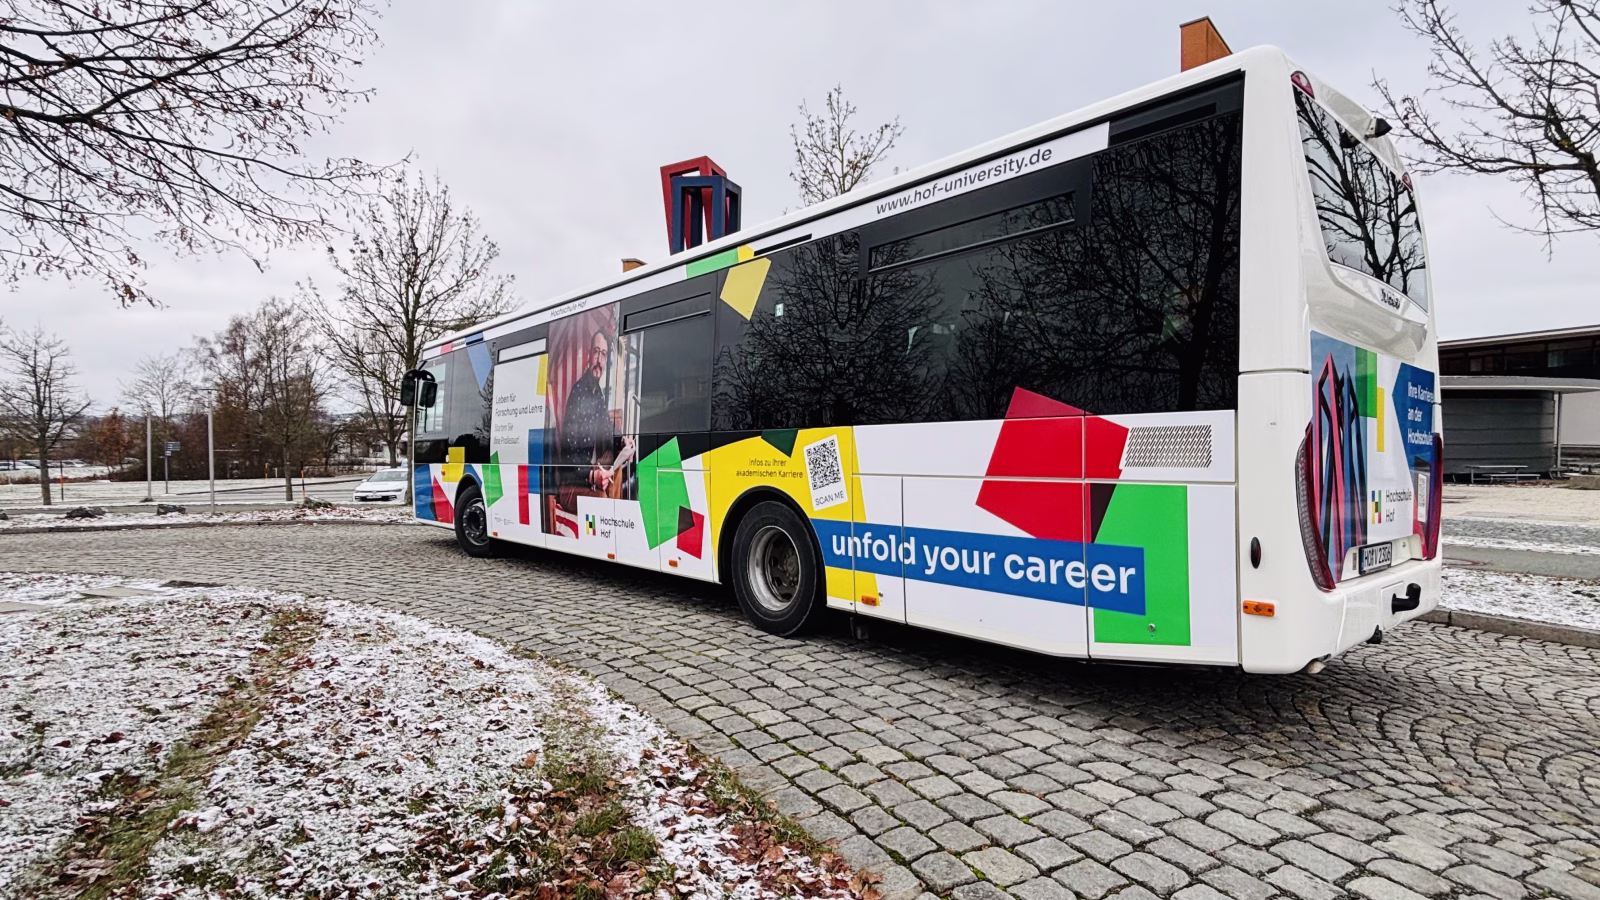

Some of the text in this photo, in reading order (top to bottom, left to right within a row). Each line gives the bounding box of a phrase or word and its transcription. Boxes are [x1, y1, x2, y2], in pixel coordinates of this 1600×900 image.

[876, 148, 1053, 215] www.hof-university.de
[577, 299, 588, 309] Hof
[495, 395, 509, 404] Leben
[495, 404, 543, 418] Forschung und Lehre
[1407, 406, 1423, 422] an der
[1407, 428, 1433, 446] Hochschule
[749, 458, 763, 467] Infos
[772, 459, 787, 467] Ihrer
[736, 469, 804, 479] akademischen Karriere
[815, 490, 845, 506] SCAN ME
[1385, 488, 1412, 503] Hochschule
[1385, 508, 1395, 523] Hof
[600, 514, 635, 539] Hochschule Hof
[832, 532, 1136, 595] unfold your career
